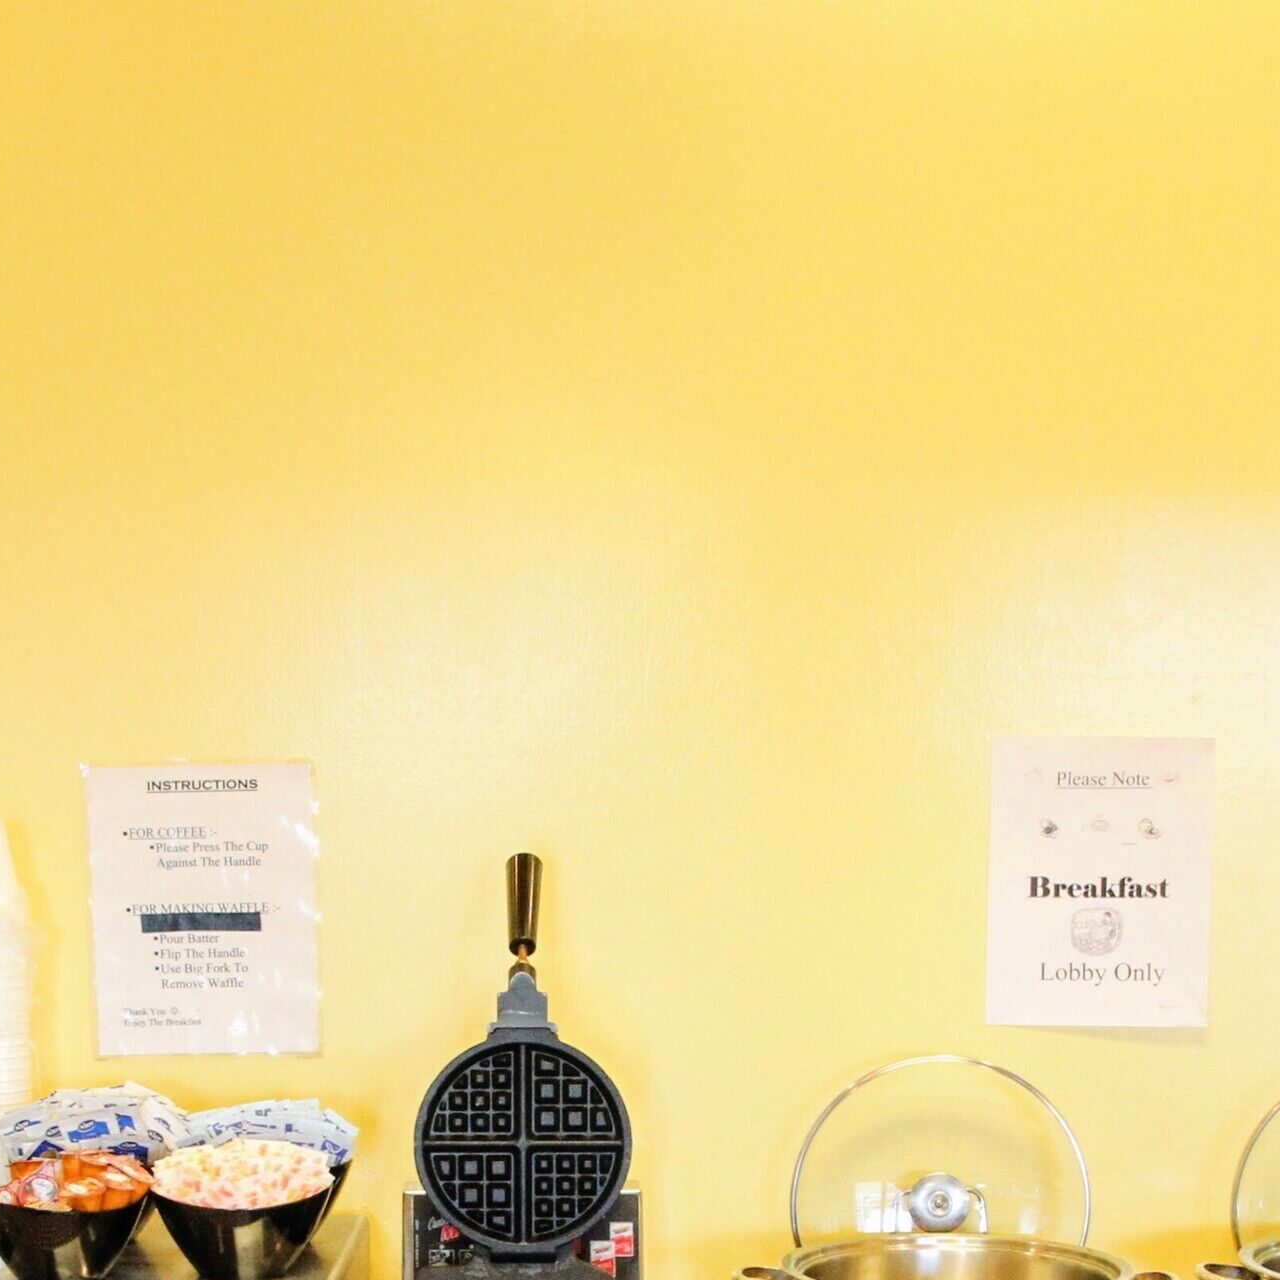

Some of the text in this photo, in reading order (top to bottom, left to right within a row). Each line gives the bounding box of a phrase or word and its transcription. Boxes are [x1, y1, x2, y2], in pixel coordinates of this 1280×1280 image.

[1056, 771, 1150, 786] Please Note
[146, 779, 259, 791] INSTRUCTIONS
[128, 827, 154, 838] FOR
[157, 826, 206, 838] COFFEE
[155, 841, 269, 853] Please Press The Cup
[156, 856, 261, 871] Against The Handle
[1028, 875, 1170, 899] Breakfast
[132, 904, 157, 914] FOR
[161, 903, 214, 914] MAKING
[218, 902, 269, 914] WAFFLE
[159, 934, 220, 944] Pour Batter
[159, 948, 245, 961] Flip The Handle
[161, 963, 249, 976] Use Big Fork To
[1040, 962, 1165, 986] Lobby Only
[161, 977, 245, 989] Remove Waffle
